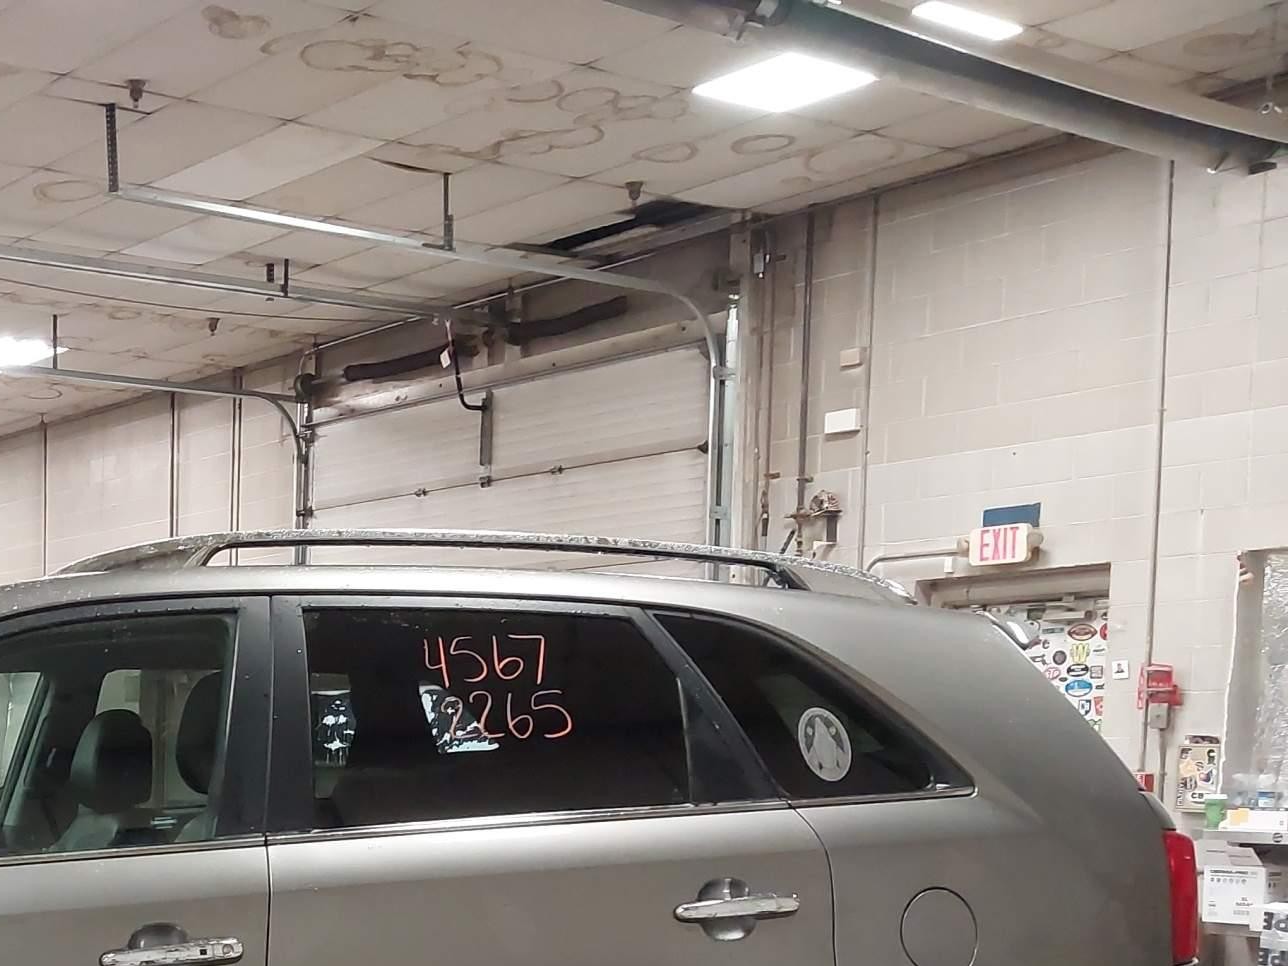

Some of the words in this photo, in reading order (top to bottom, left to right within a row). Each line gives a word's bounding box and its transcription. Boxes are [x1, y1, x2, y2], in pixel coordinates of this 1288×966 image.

[979, 526, 1020, 562] EXIT
[423, 633, 546, 688] 4567
[440, 689, 573, 739] 2265
